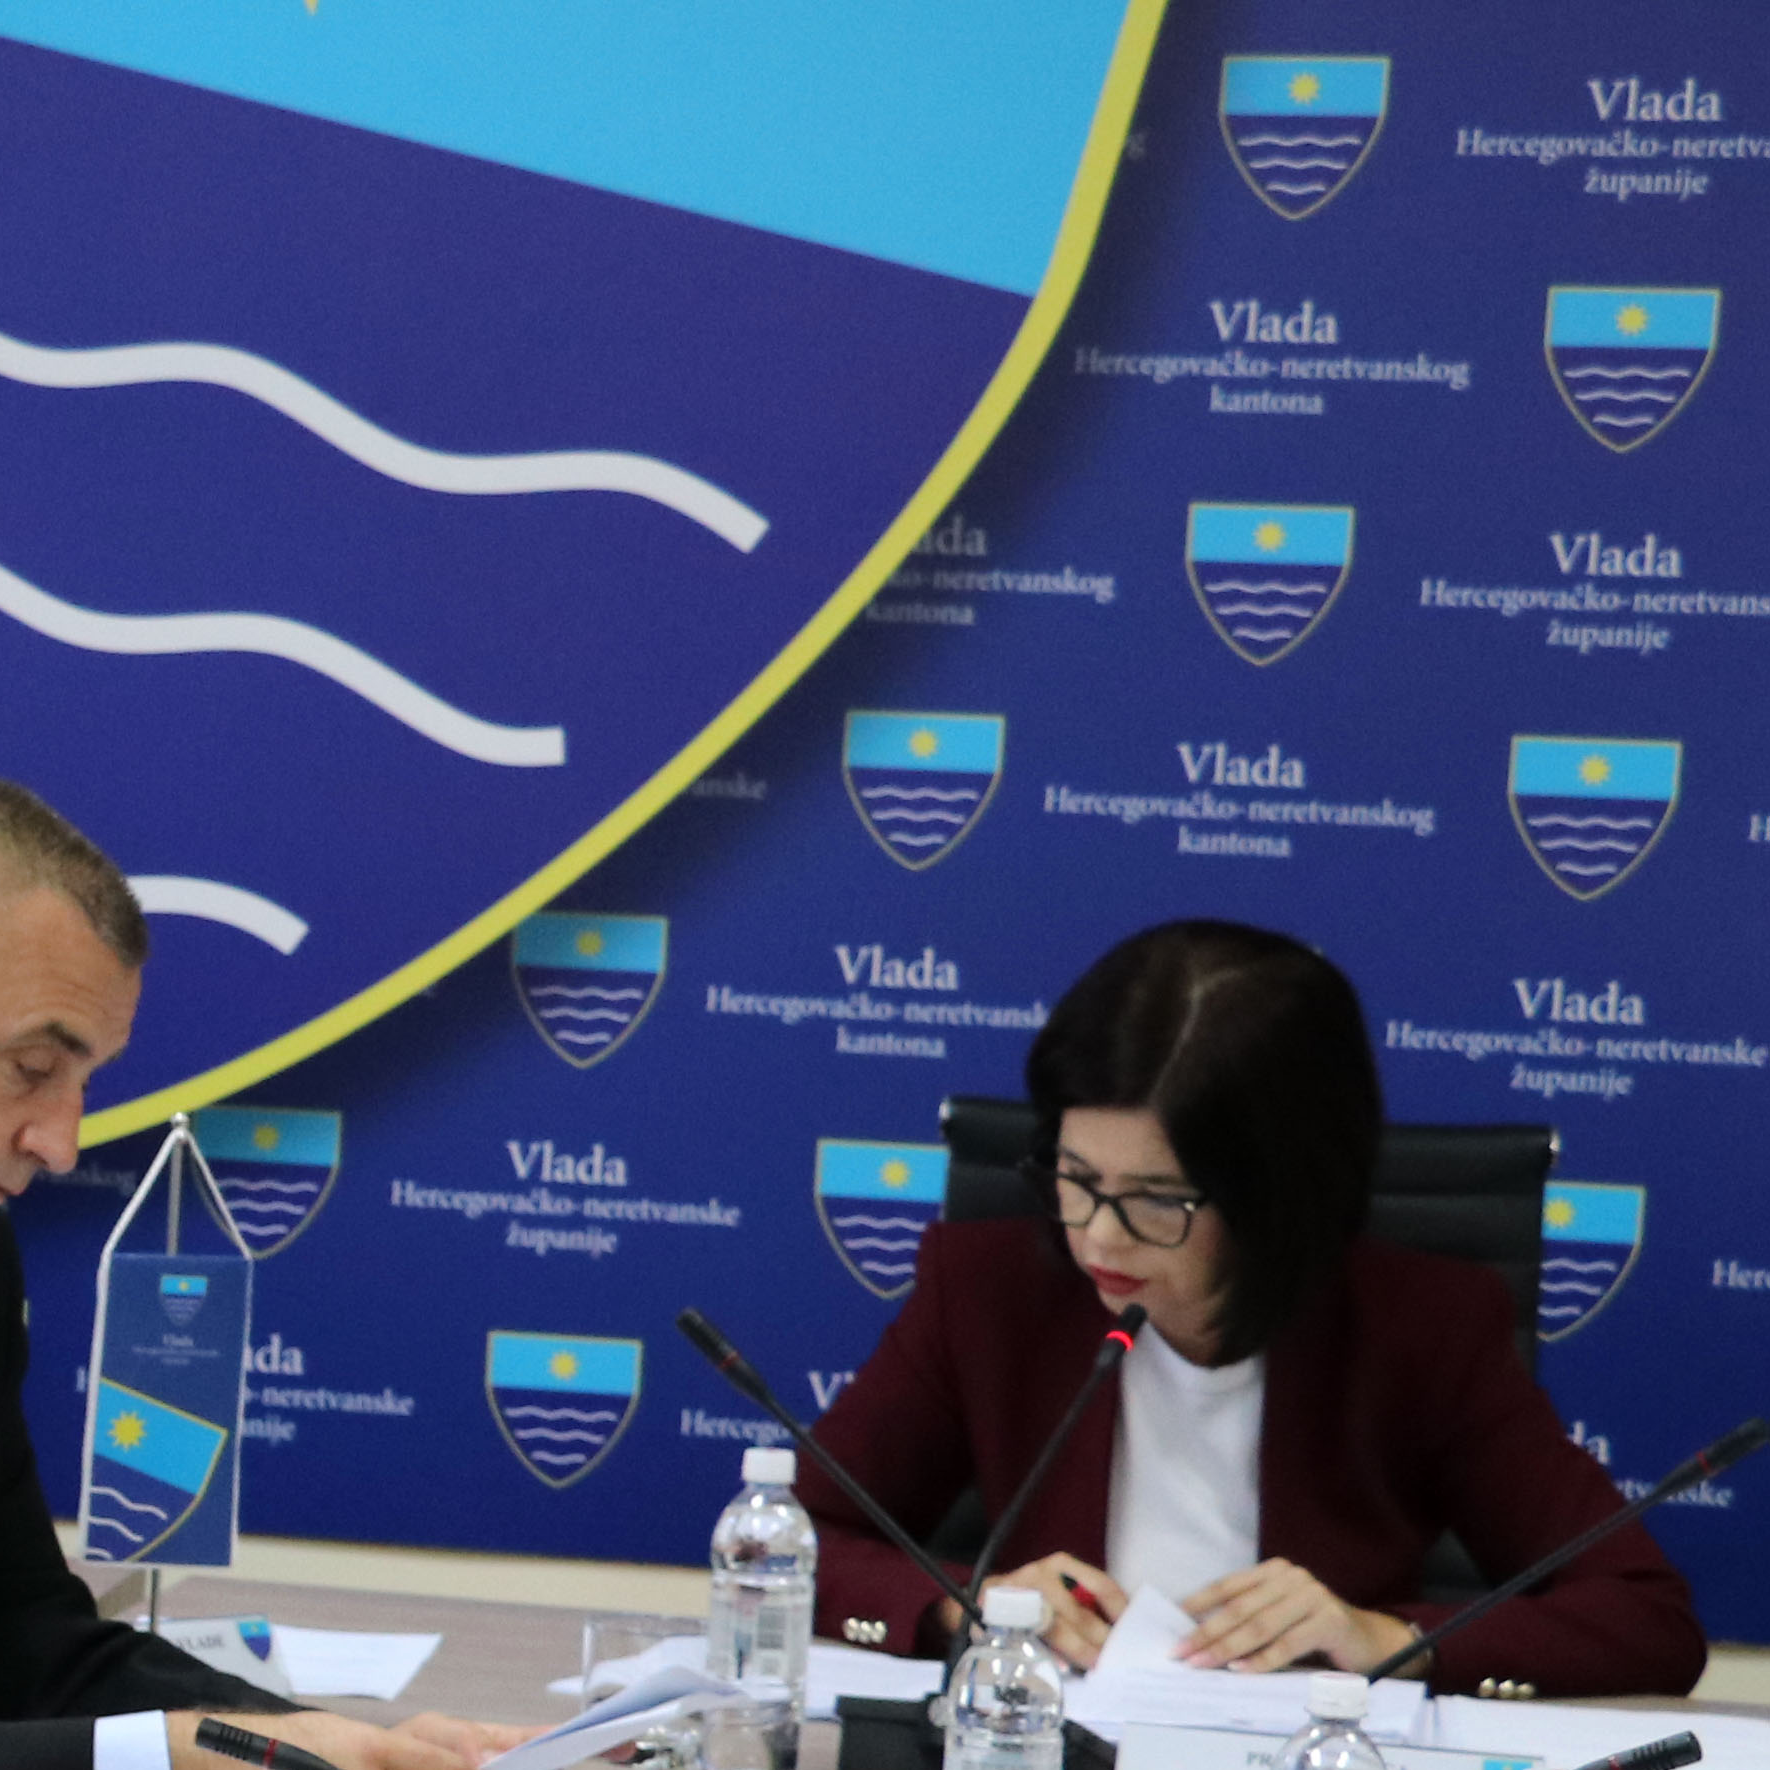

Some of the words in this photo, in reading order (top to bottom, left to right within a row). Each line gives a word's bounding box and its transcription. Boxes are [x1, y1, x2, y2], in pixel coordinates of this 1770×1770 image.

[1587, 76, 1722, 121] Vlada
[1583, 166, 1709, 202] županije
[1209, 299, 1339, 344] Vlada
[1075, 347, 1470, 391] Hercegovačko-neretvanskog
[1209, 383, 1324, 416] kantona
[1549, 532, 1683, 578] Vlada
[1545, 620, 1671, 656] županije
[1176, 741, 1306, 789] Vlada
[1043, 785, 1435, 837] Hercegovačko-neretvanskog
[1177, 824, 1292, 857] kantona
[834, 944, 960, 991] Vlada
[705, 984, 1049, 1031] Hercegovačko-neretvansk
[1514, 977, 1646, 1026] Vlada
[835, 1024, 947, 1059] kantona
[1385, 1019, 1769, 1069] Hercegovačko-neretvanske
[1510, 1063, 1634, 1101] županije
[506, 1138, 627, 1187] Vlada
[390, 1178, 741, 1228] Hercegovačko-neretvanske
[506, 1220, 618, 1258] županije
